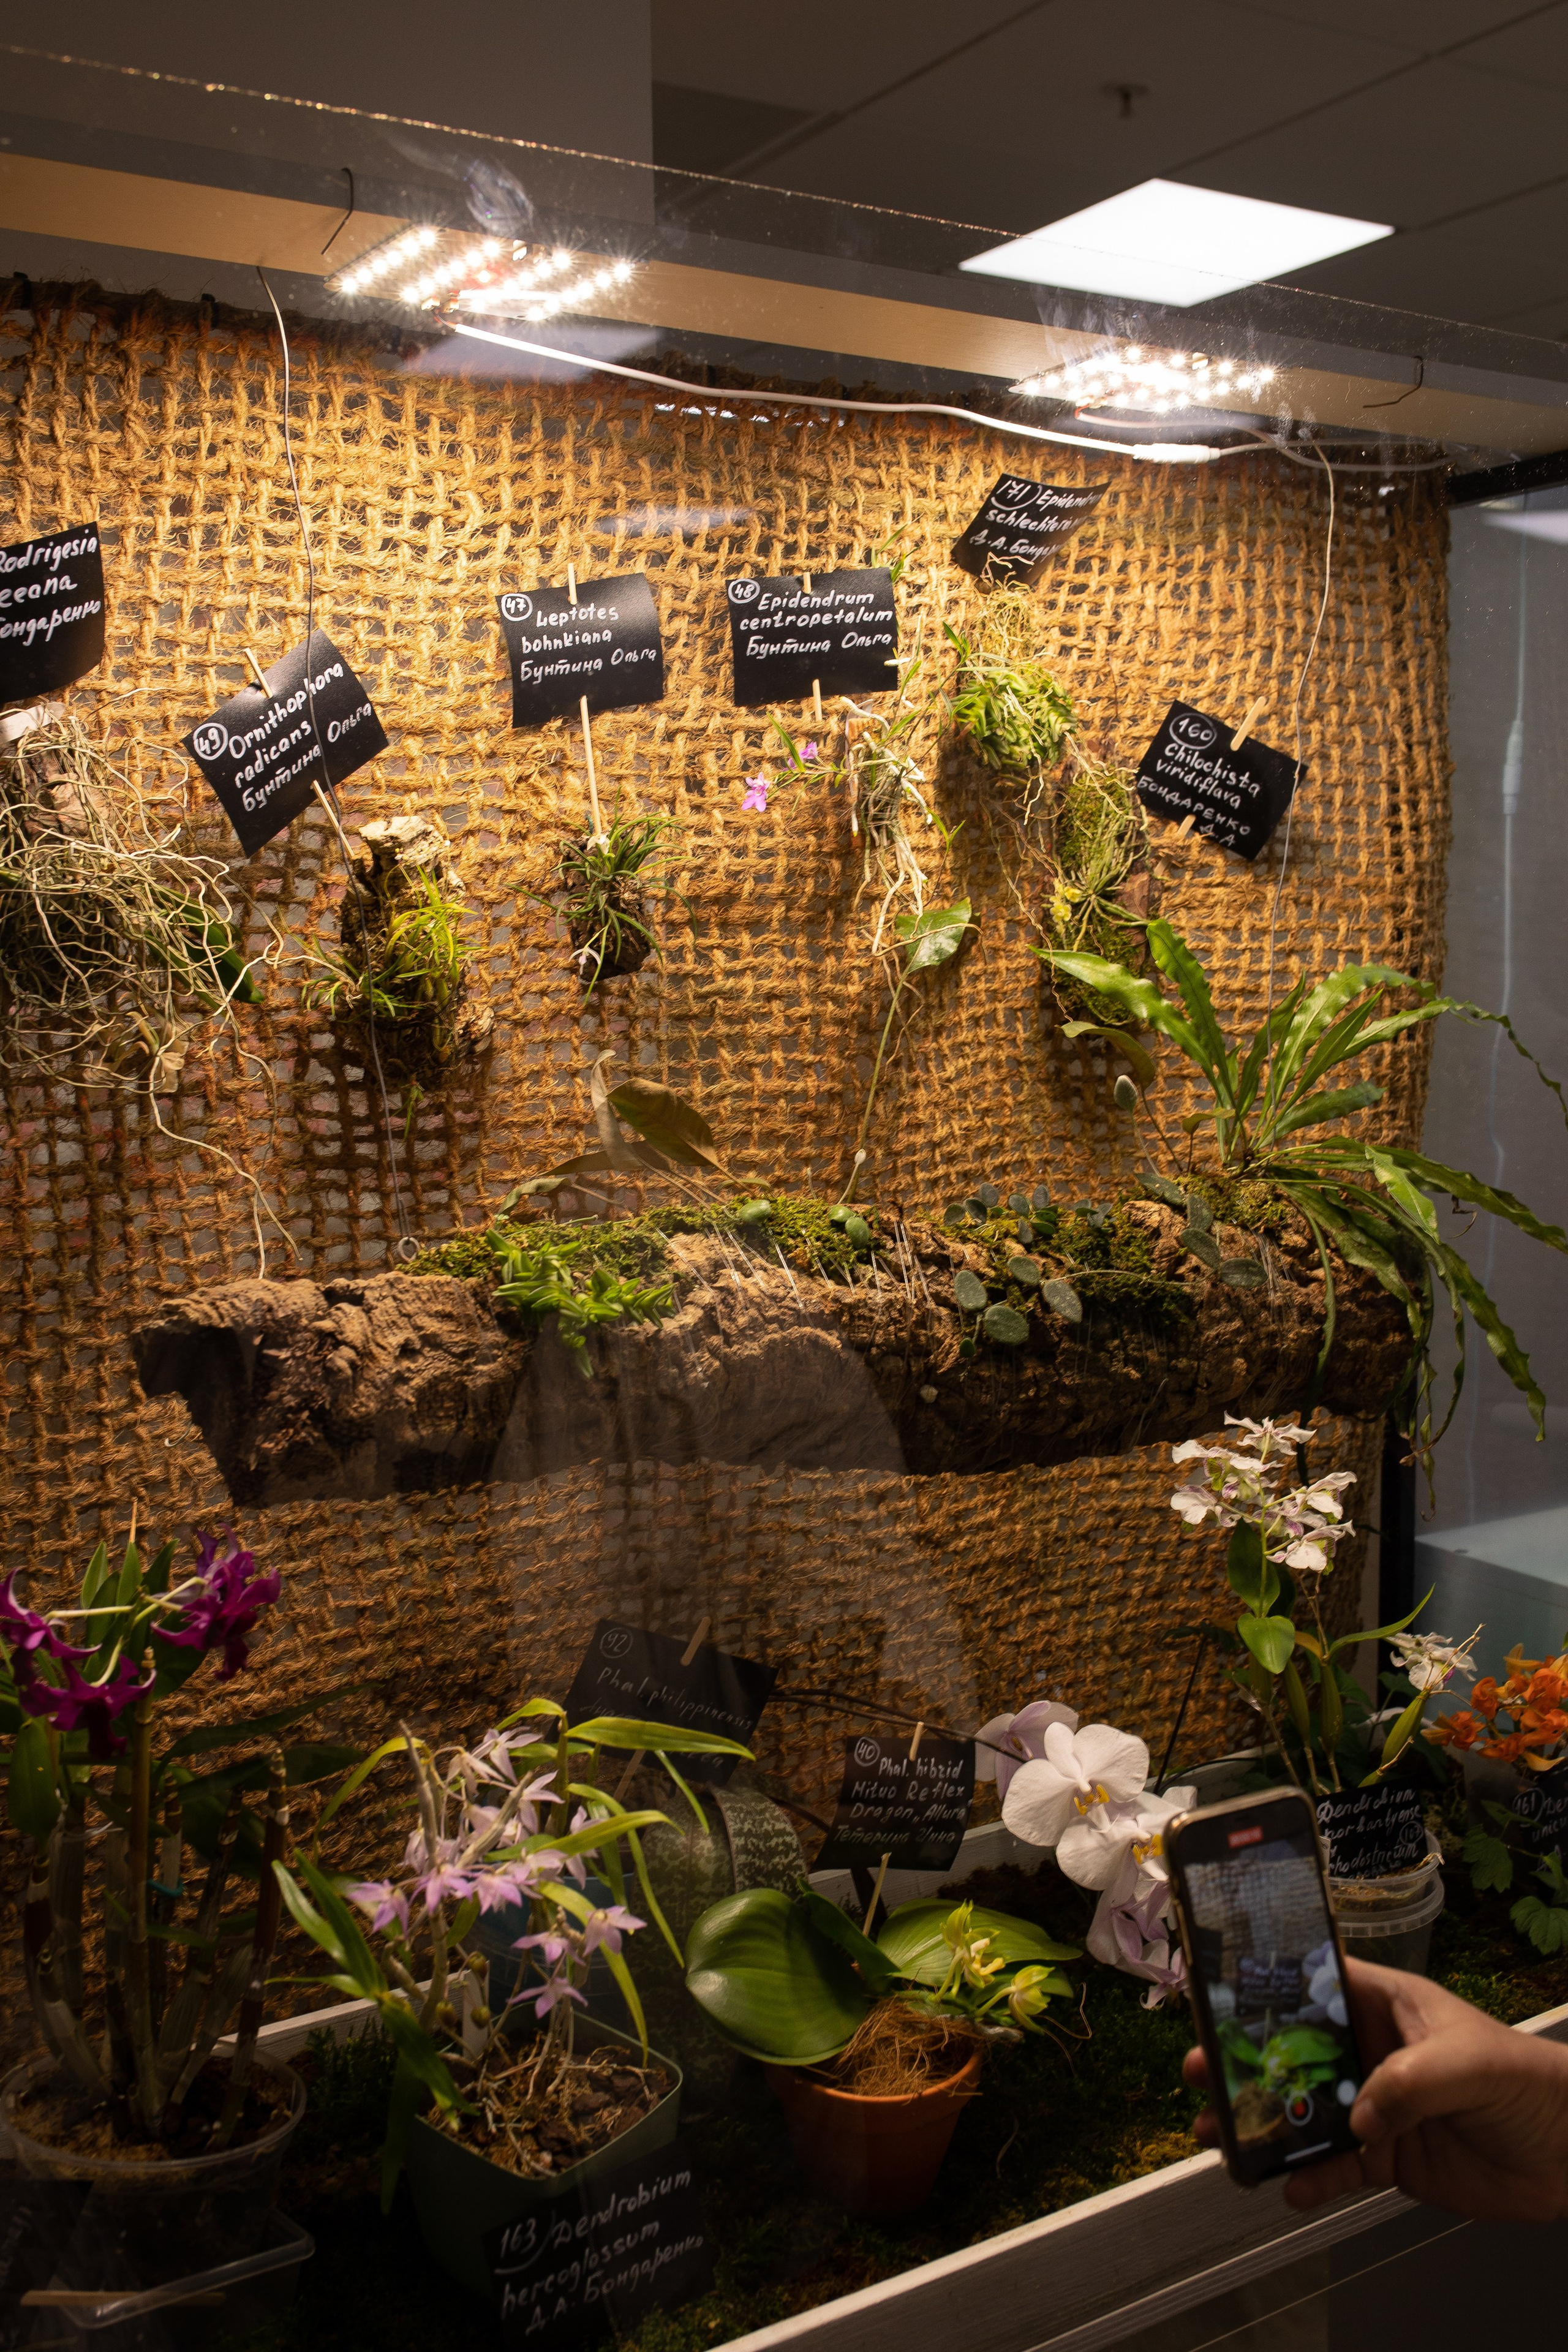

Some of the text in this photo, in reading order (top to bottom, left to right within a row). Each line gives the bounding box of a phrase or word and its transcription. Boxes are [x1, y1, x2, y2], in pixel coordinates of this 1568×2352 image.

[996, 480, 1031, 502] 171
[0, 575, 78, 608] eeana
[734, 583, 875, 611] 48 Epidendrum
[0, 600, 101, 646] ондаренко
[506, 597, 619, 628] 47 Leptotes
[739, 606, 893, 631] centropetalum
[746, 631, 892, 660] Бунтина Ольга
[520, 647, 657, 685] Бунтина Ольга
[195, 663, 344, 759] 49 Ornithophora
[327, 703, 372, 743] Ольга
[1178, 717, 1213, 741] 160
[235, 720, 312, 788] radicans
[1155, 758, 1241, 810] viridiflava
[1164, 742, 1262, 797] Chilochista
[605, 1633, 628, 1652] 92
[858, 1742, 875, 1760] 40
[906, 1780, 965, 1801] Reflex
[1515, 1792, 1536, 1815] 161
[850, 1803, 914, 1823] Dragon
[1532, 1817, 1568, 1843] unicu
[500, 2170, 691, 2260] 163 Dendrobium
[501, 2220, 660, 2320] hercoglossum
